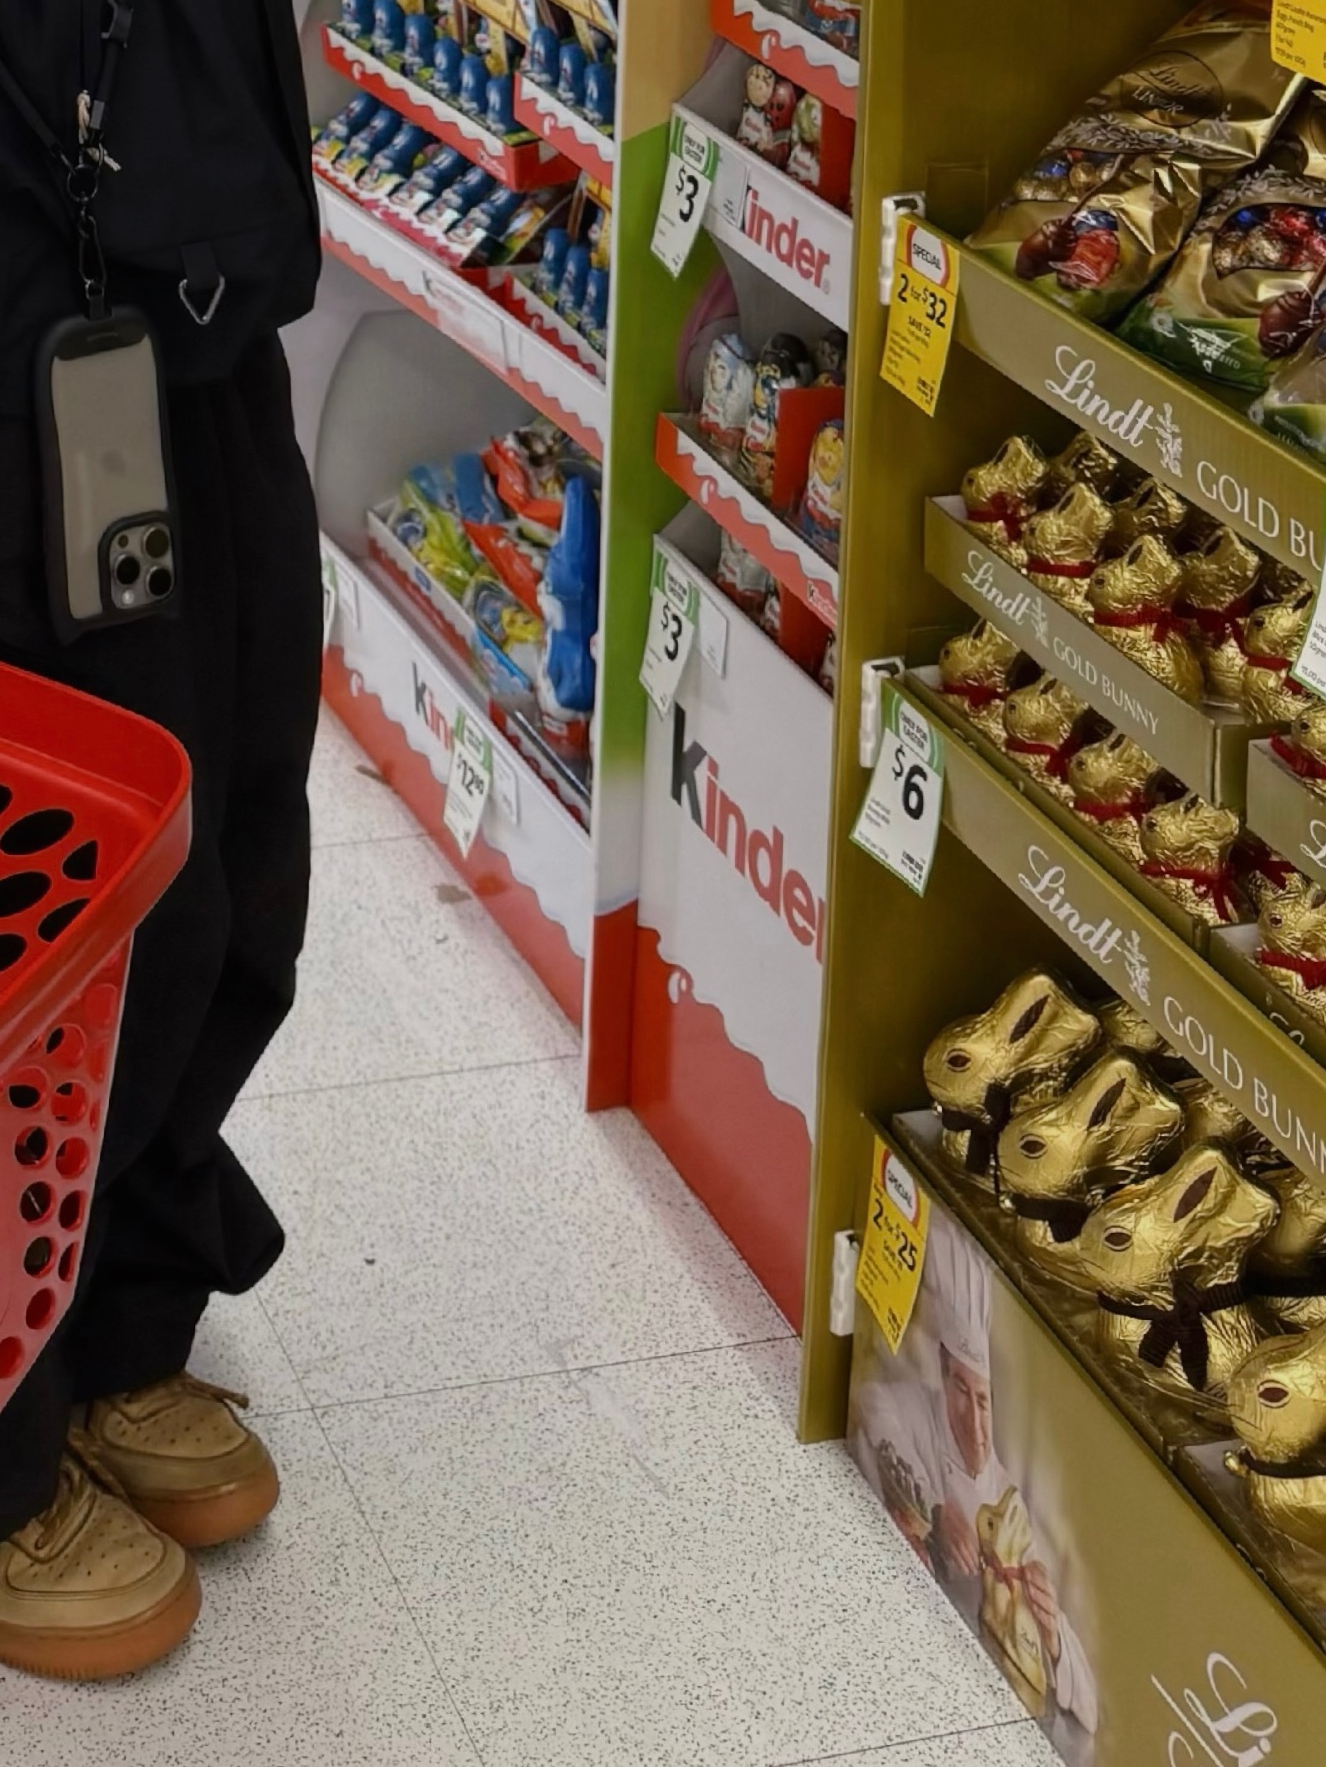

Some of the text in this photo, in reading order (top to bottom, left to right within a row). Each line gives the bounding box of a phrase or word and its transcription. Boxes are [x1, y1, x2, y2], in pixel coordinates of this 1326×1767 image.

[676, 166, 699, 223] $3
[744, 184, 831, 294] inder
[912, 243, 942, 270] SPECIAL
[897, 273, 909, 303] 2
[922, 285, 948, 329] $32
[1045, 345, 1159, 449] Lindt
[1196, 461, 1280, 538] GOLD
[661, 601, 683, 662] $3
[961, 550, 1159, 735] Lindt GOLD BUNNY
[892, 744, 928, 821] $6
[1018, 844, 1124, 964] Lindt
[1163, 995, 1244, 1090] GOLD
[874, 1198, 884, 1231] 2
